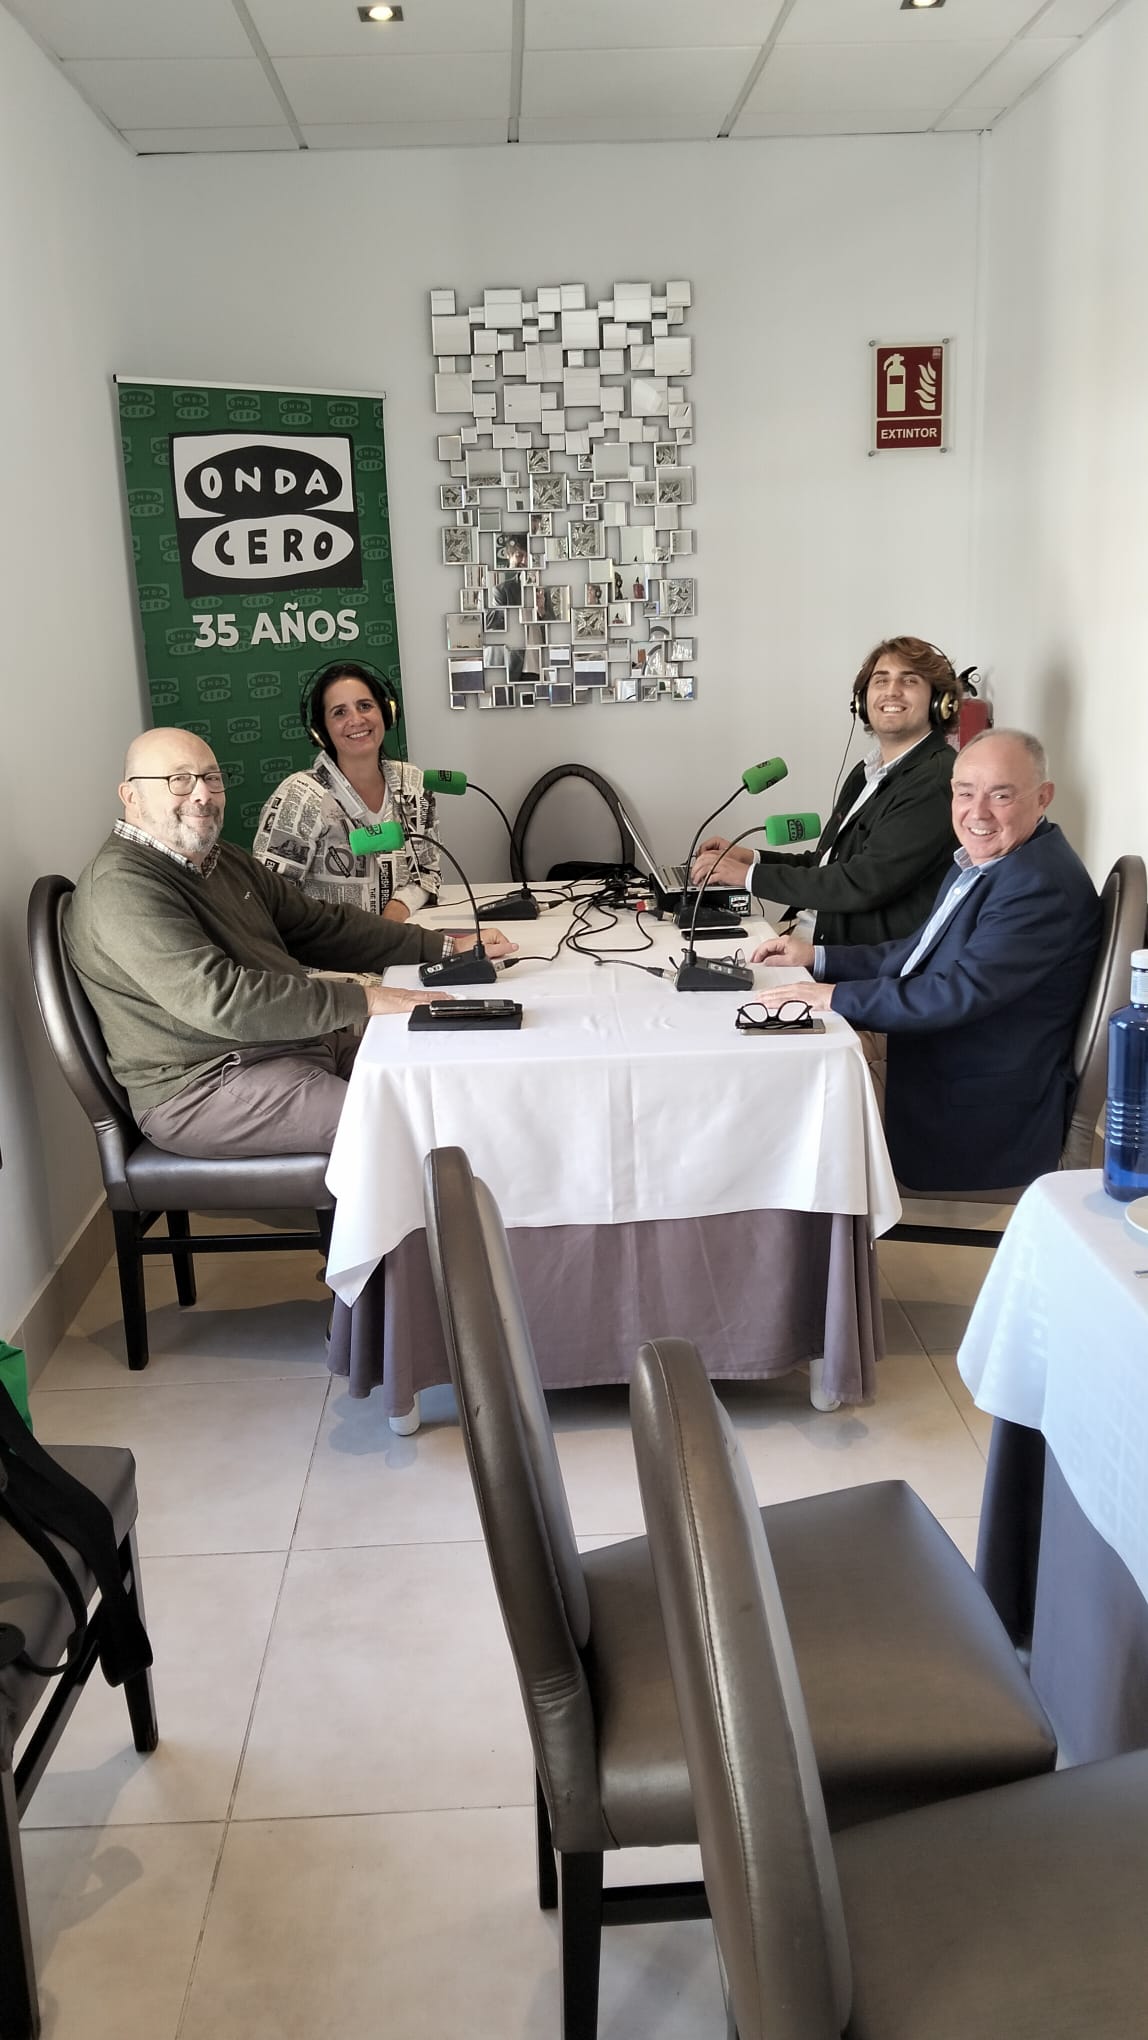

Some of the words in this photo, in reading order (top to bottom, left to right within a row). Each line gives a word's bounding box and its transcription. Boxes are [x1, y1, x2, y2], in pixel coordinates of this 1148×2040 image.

[880, 427, 937, 439] EXTINTOR
[200, 466, 328, 499] ONDA
[214, 528, 333, 566] CERO
[192, 613, 240, 648] 35
[251, 602, 360, 645] AÑOS
